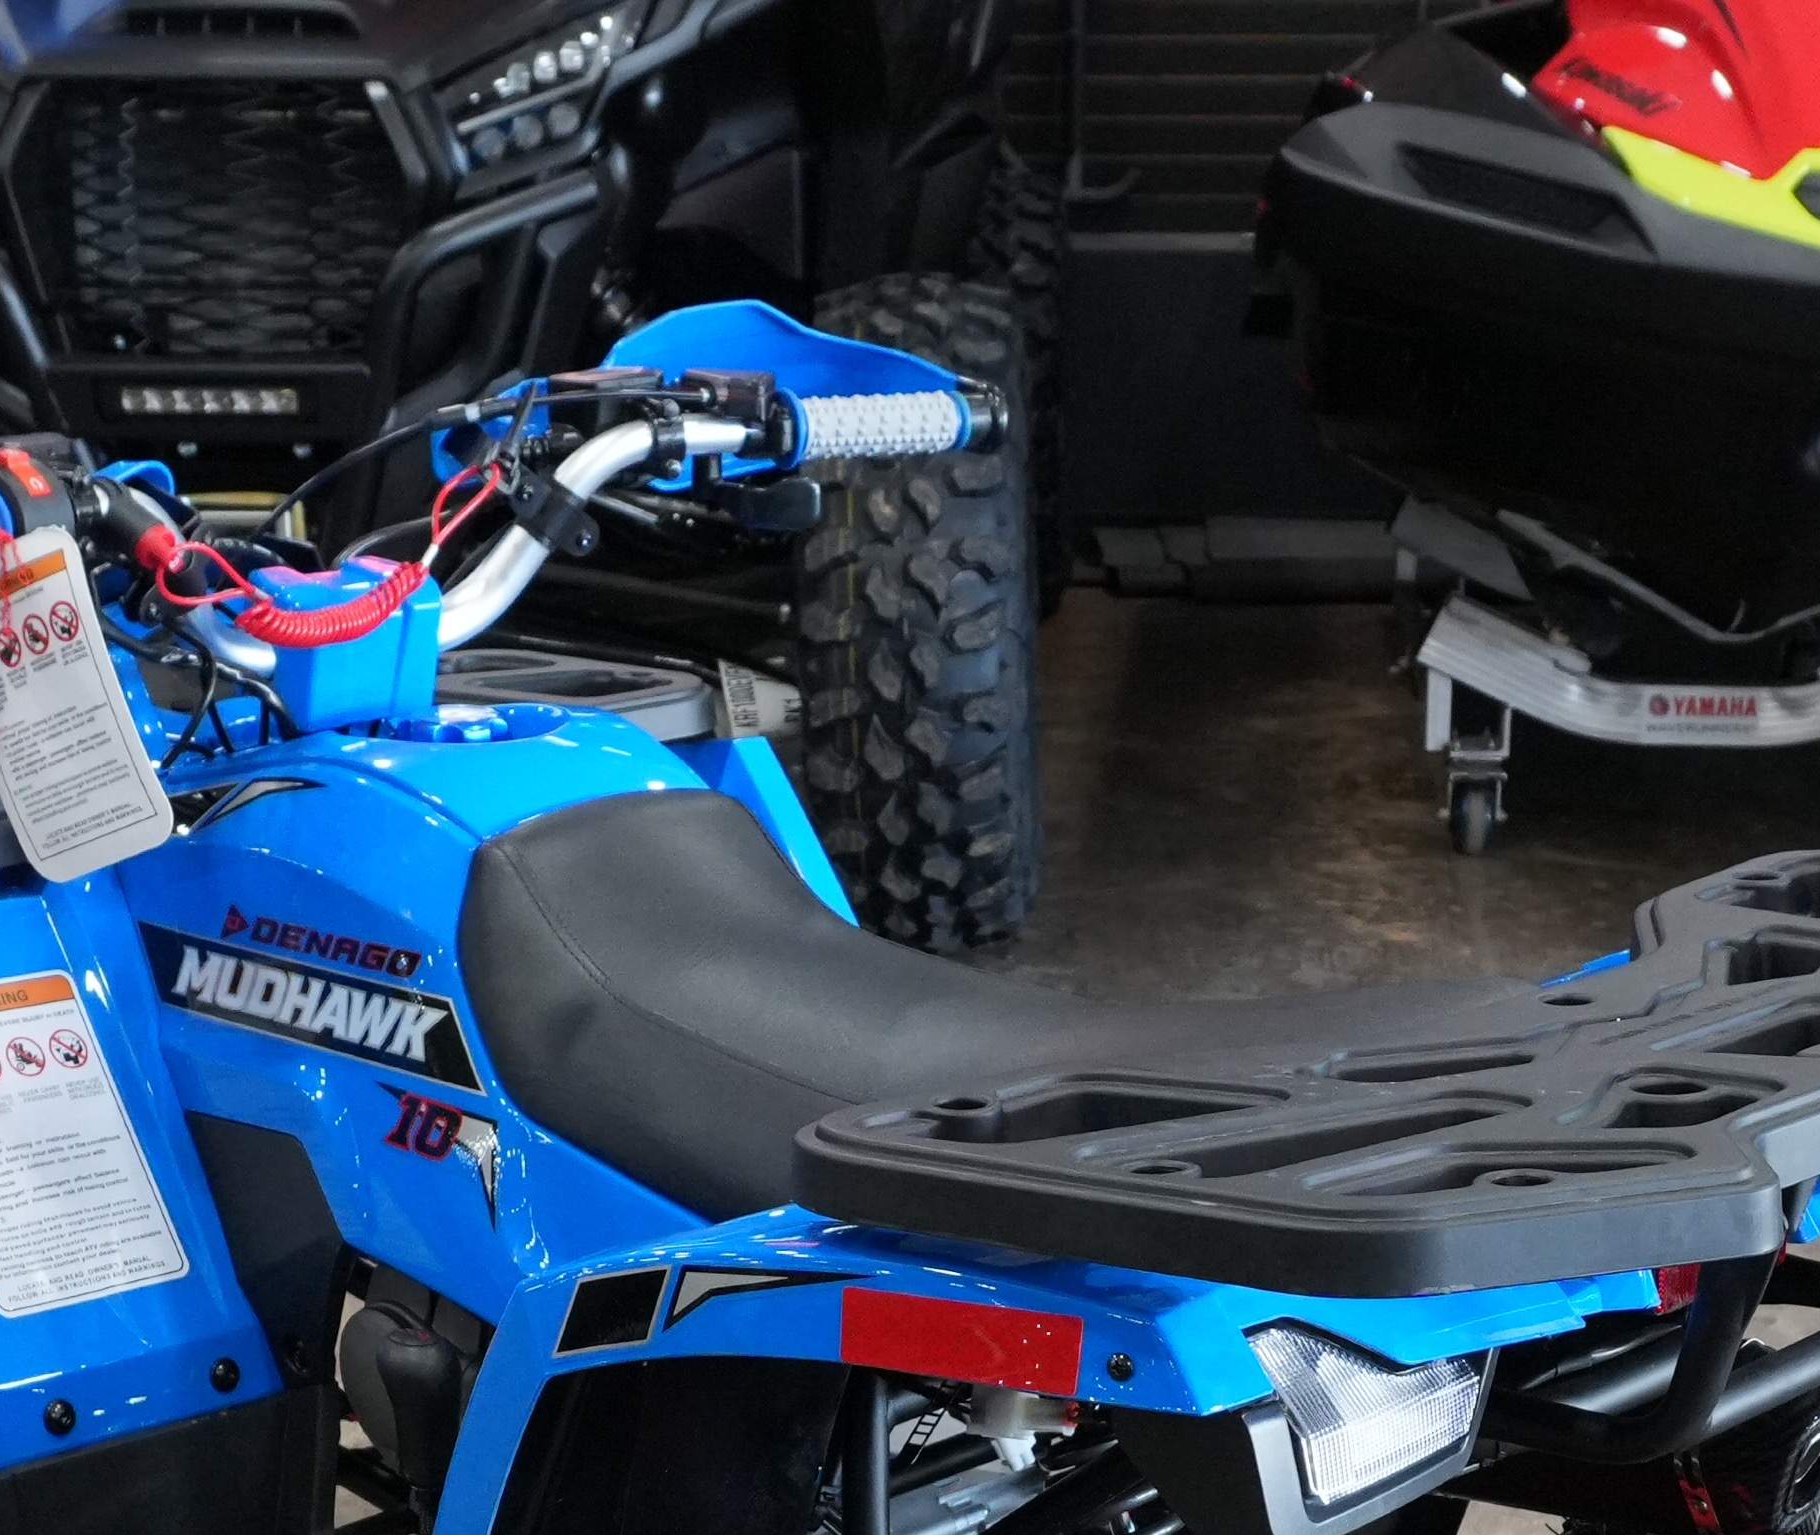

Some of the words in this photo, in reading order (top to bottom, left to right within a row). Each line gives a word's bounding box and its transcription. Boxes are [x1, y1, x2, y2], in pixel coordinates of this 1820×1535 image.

[1675, 695, 1757, 717] YAMAHA
[251, 915, 422, 979] DENAGO
[172, 945, 449, 1063] MUDHAWK
[382, 1091, 464, 1162] 10
[30, 1149, 47, 1158] your
[86, 1133, 120, 1145] conditions
[30, 1192, 60, 1203] increase
[104, 1176, 129, 1186] control
[64, 1217, 86, 1227] rough
[67, 1224, 102, 1236] pavement
[117, 1214, 150, 1226] seriously
[13, 1247, 46, 1260] handling
[60, 1236, 87, 1247] control
[63, 1247, 83, 1256] teach
[83, 1243, 98, 1251] ATV
[52, 1257, 80, 1268] contact
[81, 1253, 98, 1262] your
[7, 1290, 37, 1302] FOLLOW
[40, 1287, 52, 1295] ALL
[55, 1273, 111, 1291] INSTRUCTIONS
[111, 1269, 126, 1278] AND
[127, 1259, 165, 1274] WARNINGS
[16, 1279, 45, 1291] LOCATE
[48, 1275, 63, 1284] AND
[63, 1270, 84, 1280] READ
